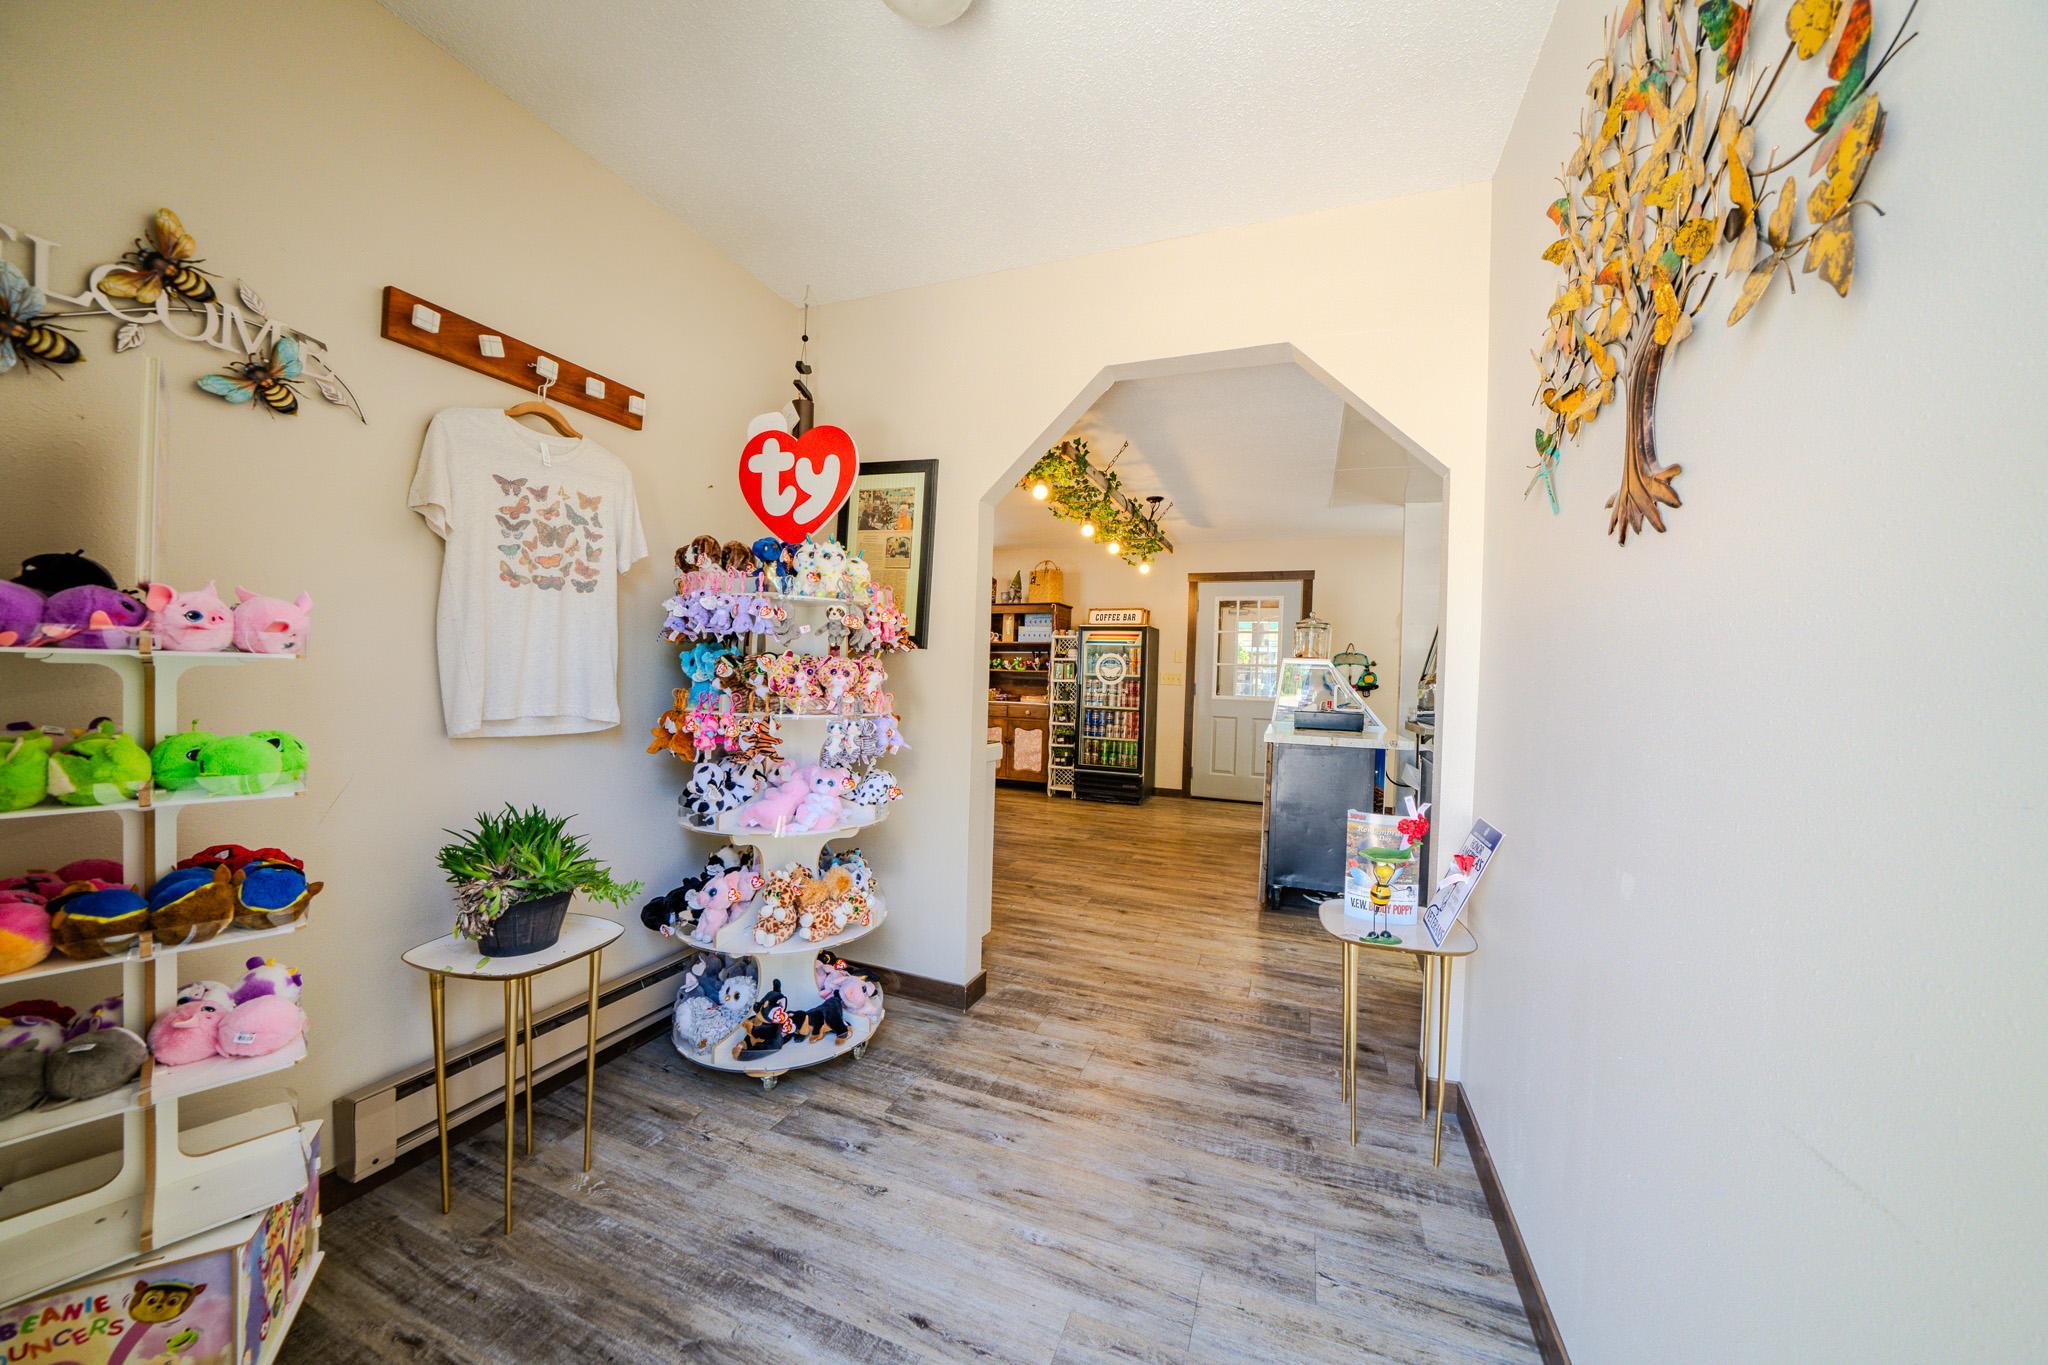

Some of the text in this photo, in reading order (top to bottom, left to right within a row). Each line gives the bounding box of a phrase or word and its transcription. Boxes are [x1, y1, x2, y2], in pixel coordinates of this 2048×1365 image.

[748, 437, 841, 525] ty
[1095, 613, 1136, 621] COFFEE BAR
[1393, 904, 1413, 916] POPPY
[0, 1295, 110, 1341] BEANIE
